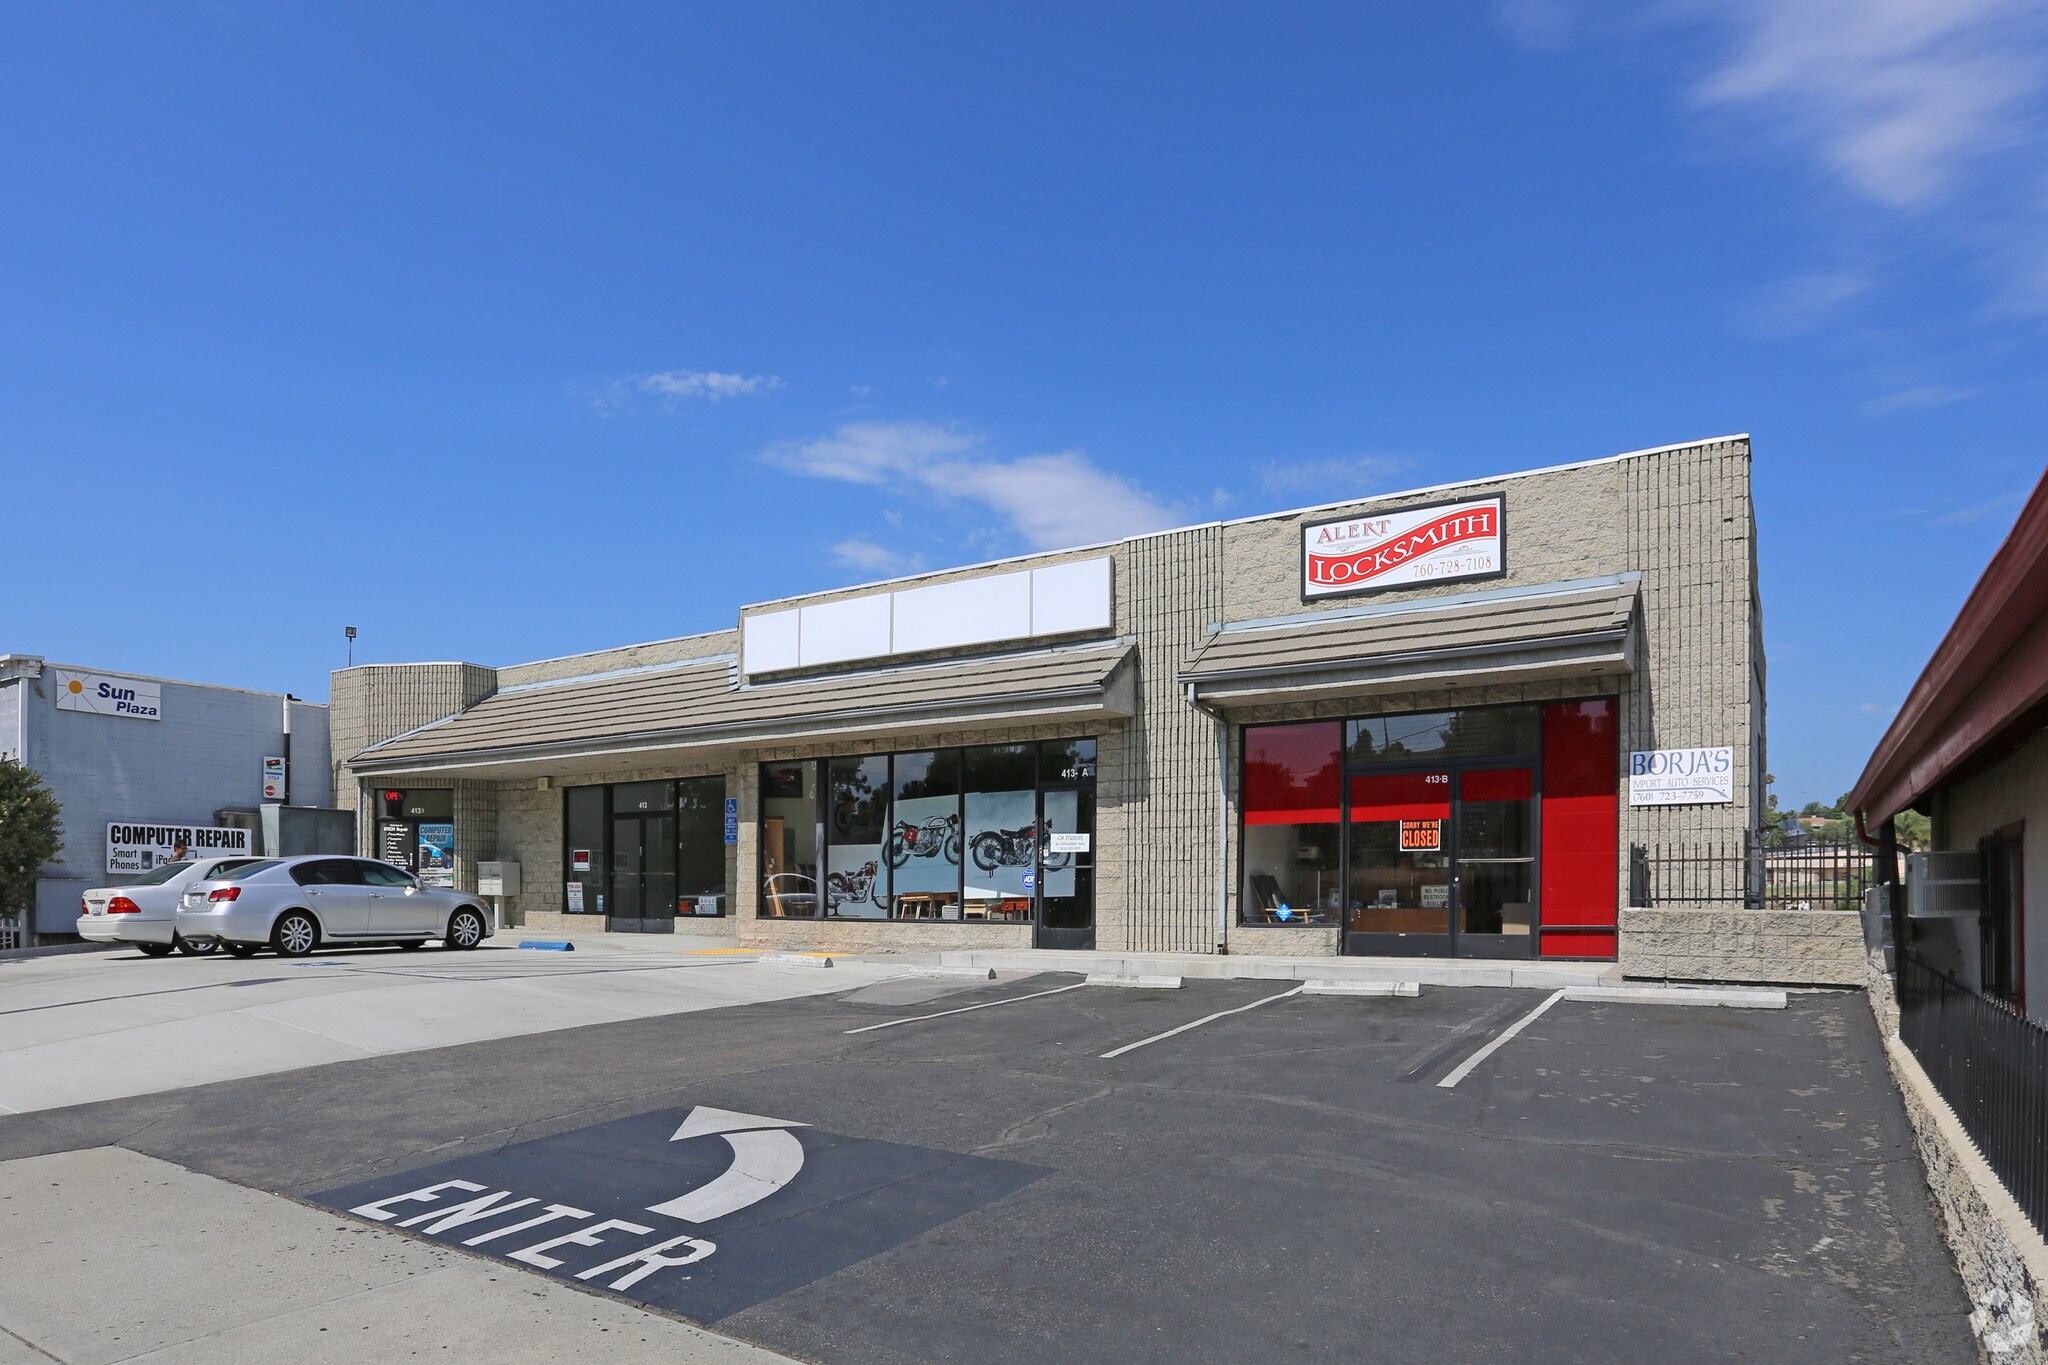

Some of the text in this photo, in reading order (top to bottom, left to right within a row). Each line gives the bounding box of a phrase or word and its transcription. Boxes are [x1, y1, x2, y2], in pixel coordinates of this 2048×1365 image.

[1316, 519, 1392, 544] ALERT
[1314, 513, 1491, 583] LOCKSMITH
[1413, 555, 1492, 578] 760-728-7108
[97, 682, 136, 702] Sun
[116, 701, 158, 717] Plaza
[1632, 748, 1730, 777] BORJA'S
[1632, 775, 1730, 789] IMPORT AUTO SERVICES
[1633, 790, 1705, 803] (760) 723-7759
[419, 825, 453, 835] COMPUTER
[1402, 821, 1421, 829] SORRY
[110, 824, 246, 849] COMPUTER REPAIR
[424, 834, 447, 843] REPAIR
[1402, 830, 1439, 848] CLOSED
[112, 847, 138, 859] Smart
[110, 858, 140, 870] Phones
[348, 1178, 718, 1292] ENTER
